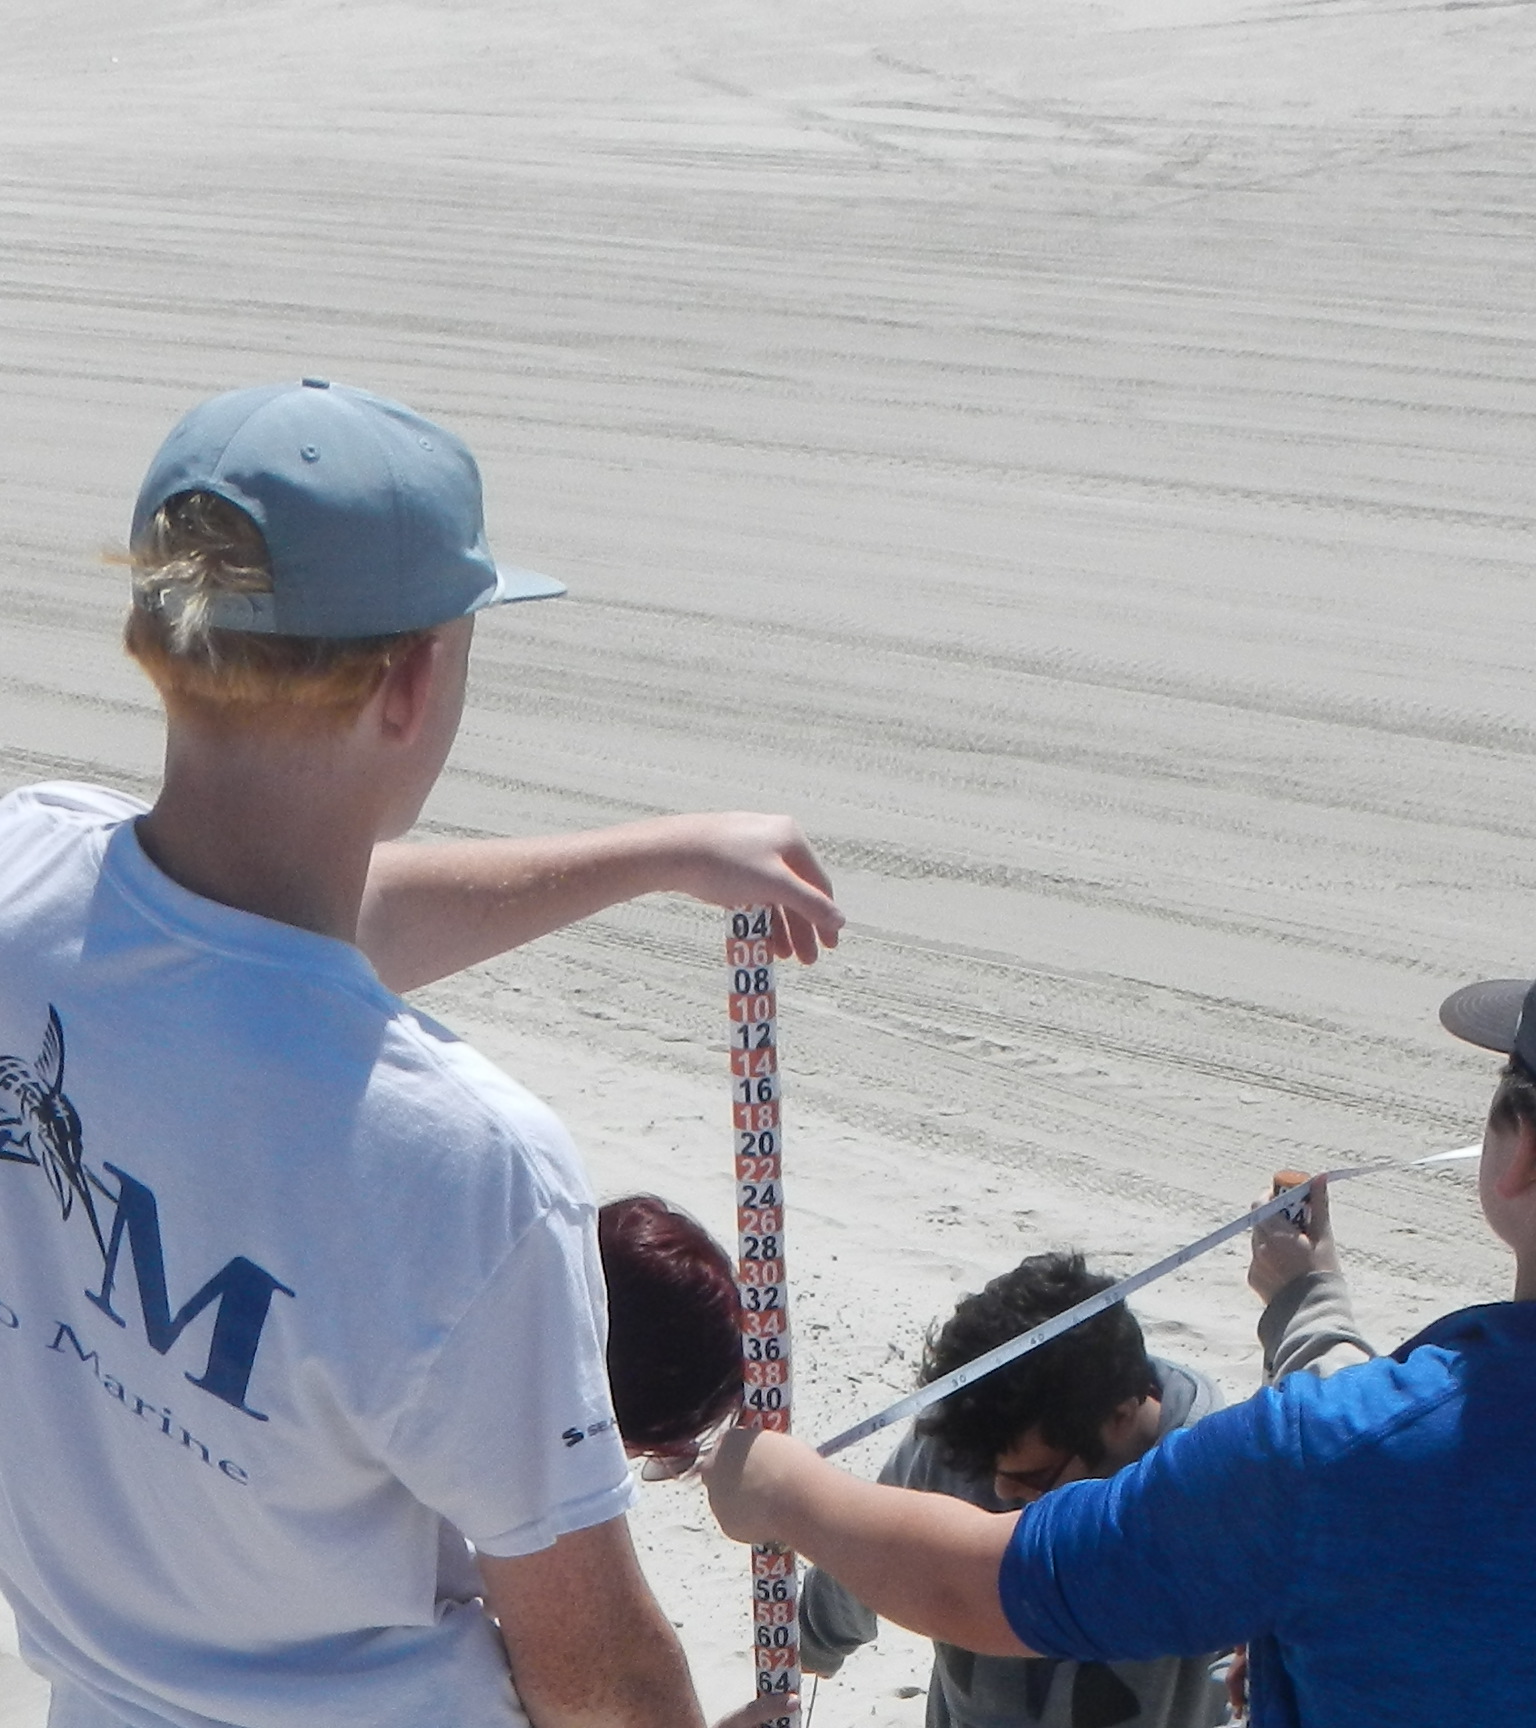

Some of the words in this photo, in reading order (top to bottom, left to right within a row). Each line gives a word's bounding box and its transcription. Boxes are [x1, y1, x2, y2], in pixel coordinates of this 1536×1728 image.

[732, 910, 768, 939] 04
[733, 941, 768, 966] 06
[734, 968, 769, 994] 08
[736, 995, 769, 1022] 10
[737, 1023, 771, 1049] 12
[738, 1051, 772, 1077] 14
[739, 1078, 772, 1102] 16
[740, 1105, 773, 1130] 18
[741, 1131, 774, 1156] 20
[741, 1158, 774, 1182] 22
[743, 1184, 776, 1208] 24
[743, 1209, 776, 1234] 26
[744, 1236, 777, 1260] 28
[745, 1261, 778, 1285] 30
[85, 1161, 296, 1422] M
[747, 1287, 779, 1312] 32
[747, 1312, 780, 1335] 34
[748, 1338, 780, 1360] 36
[749, 1363, 781, 1386] 38
[45, 1320, 249, 1485] Marine
[749, 1387, 782, 1410] 40
[755, 1554, 787, 1577] 54
[757, 1580, 787, 1601] 56
[757, 1602, 788, 1625] 58
[758, 1626, 789, 1648] 60
[758, 1649, 789, 1670] 62
[759, 1671, 790, 1694] 64
